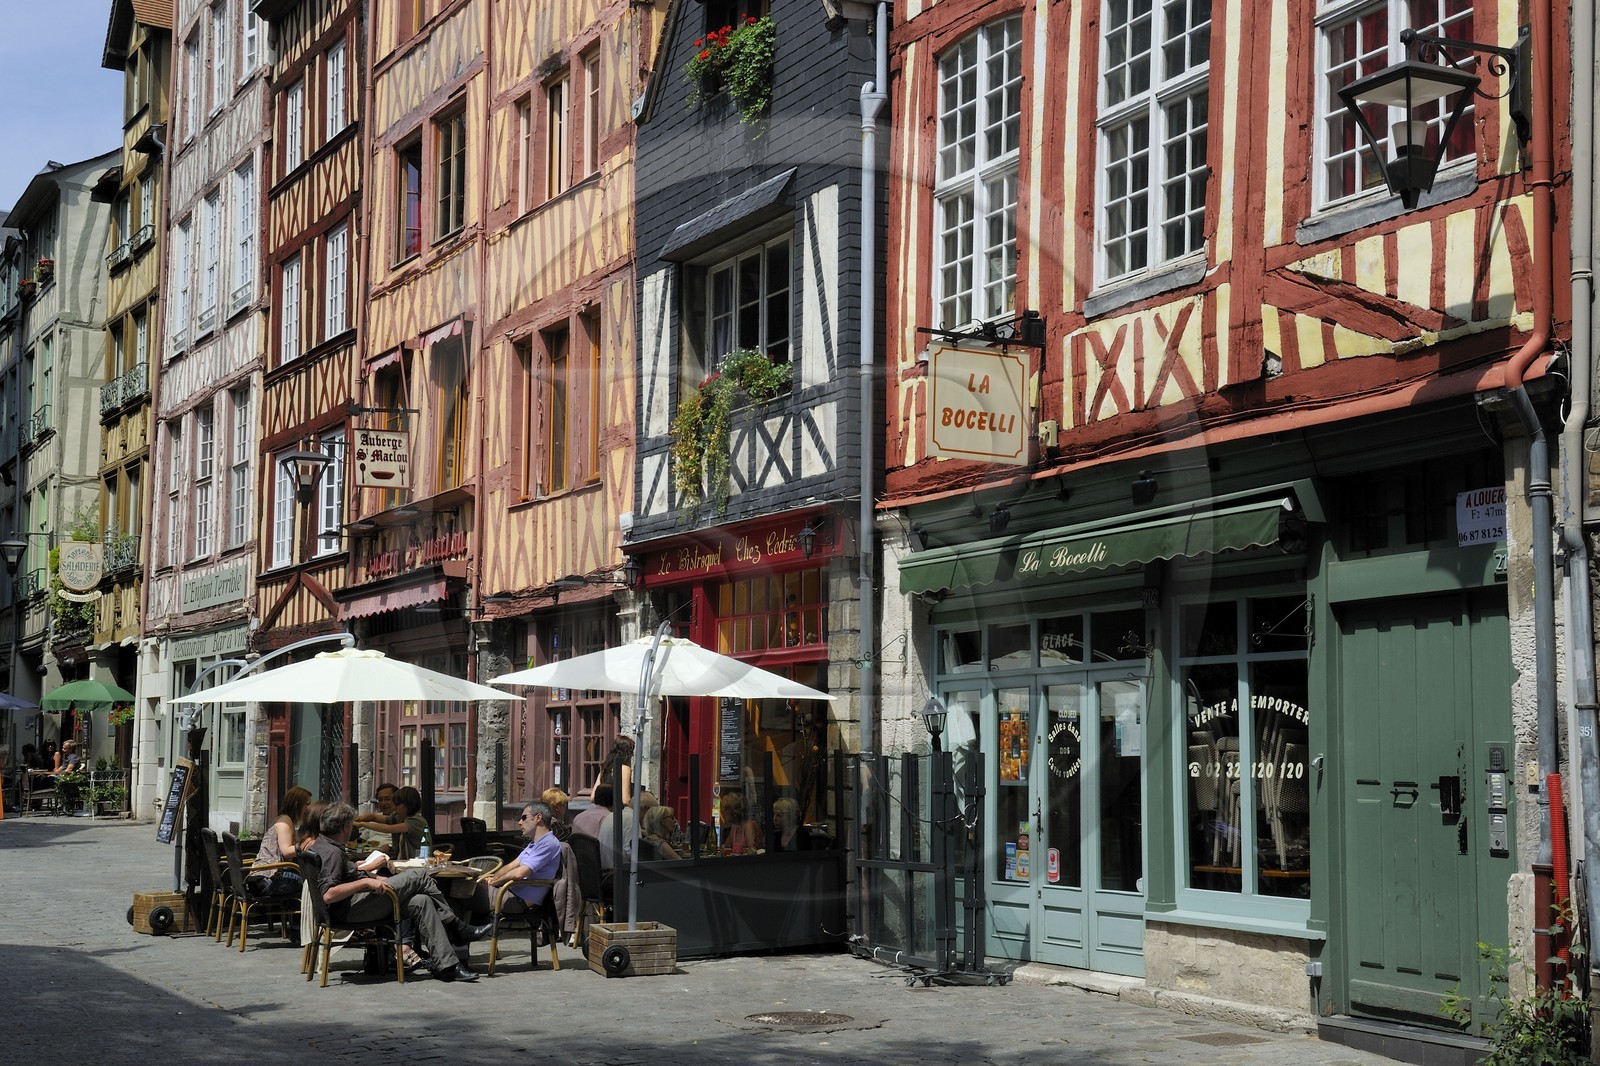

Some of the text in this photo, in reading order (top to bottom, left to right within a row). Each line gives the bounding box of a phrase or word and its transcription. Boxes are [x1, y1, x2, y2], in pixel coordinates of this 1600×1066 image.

[967, 372, 990, 394] LA
[941, 406, 1016, 434] BOCELLI
[360, 433, 403, 450] Auberge
[356, 448, 408, 463] St Maclou
[1466, 489, 1505, 508] A LOUER
[1458, 531, 1468, 542] 06
[1469, 529, 1480, 541] 87
[62, 561, 99, 571] SALADERIE
[658, 551, 671, 576] Le
[735, 535, 761, 565] Chez
[1019, 541, 1109, 573] La Bocelli
[183, 568, 242, 608] L'Enfant Terrible
[212, 631, 226, 653] Bar
[1194, 700, 1227, 728] VENTE
[1251, 695, 1309, 726] EMPORTER
[1047, 722, 1066, 743] Salles
[1206, 761, 1304, 779] 02 32 120 120
